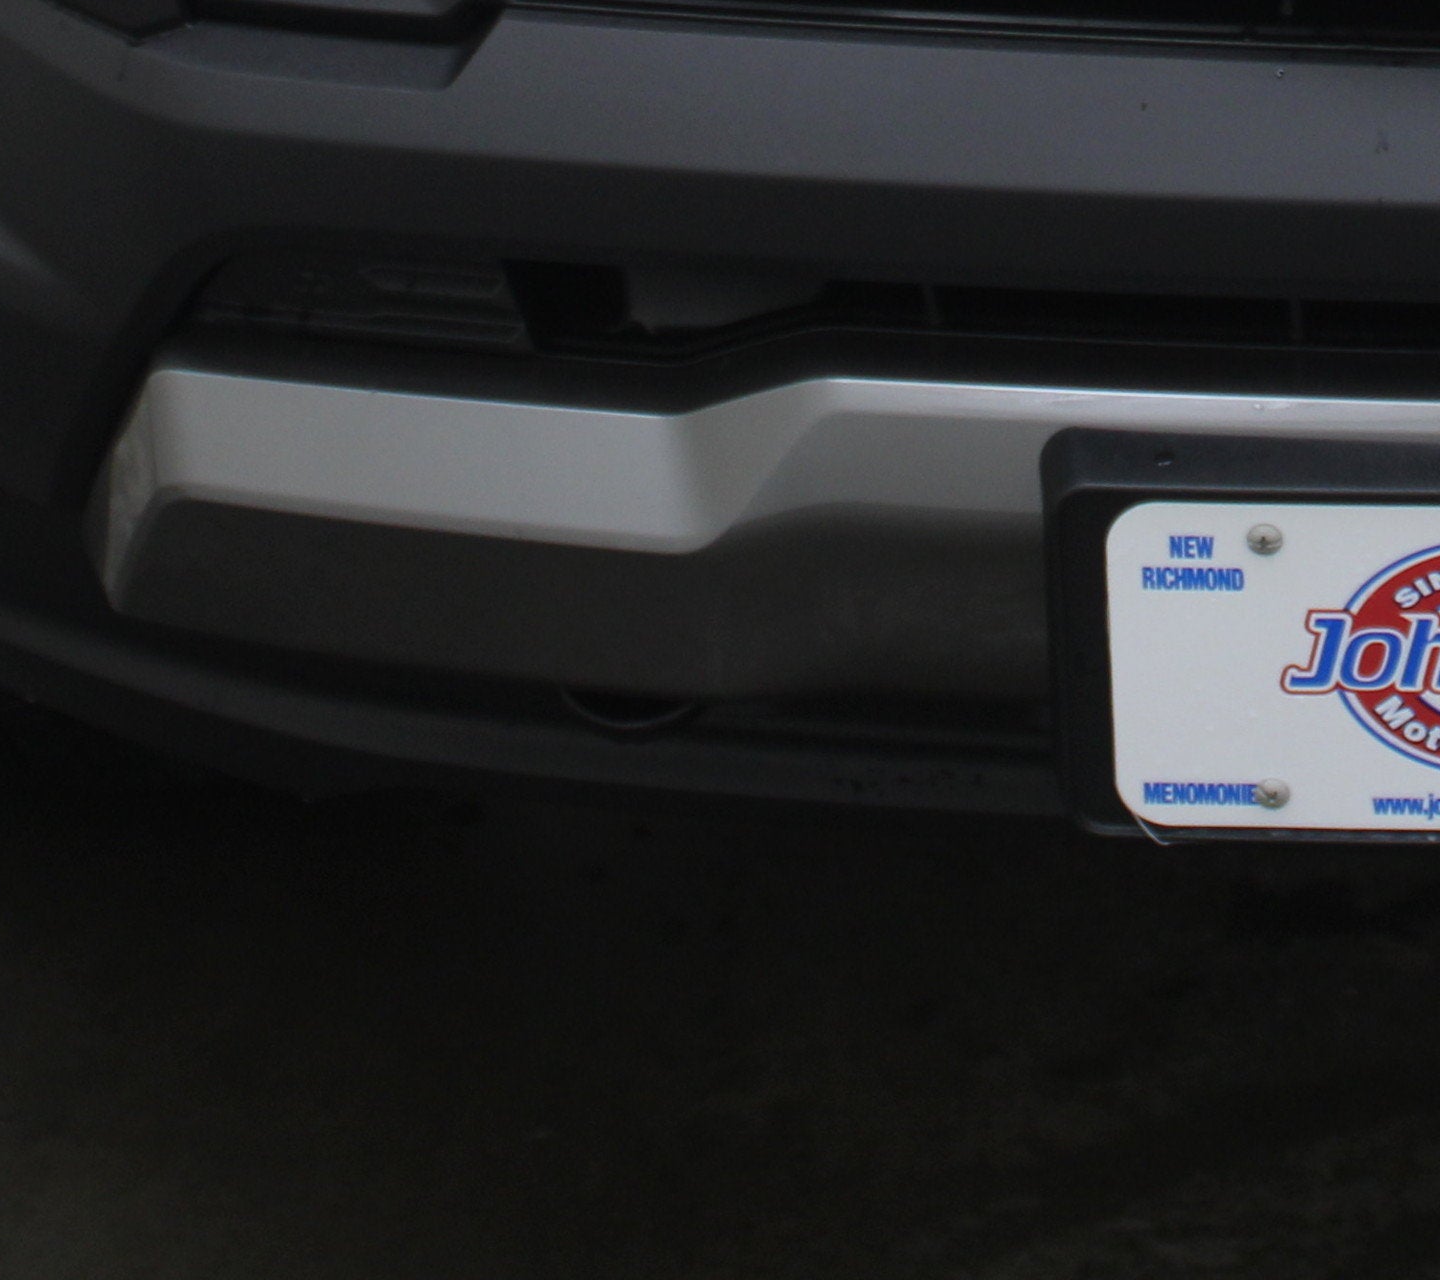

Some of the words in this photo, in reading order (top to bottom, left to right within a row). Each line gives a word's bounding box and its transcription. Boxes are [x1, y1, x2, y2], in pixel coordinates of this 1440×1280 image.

[1168, 536, 1215, 560] NEW
[1142, 567, 1245, 592] RICHMOND
[1143, 782, 1261, 806] MENOMONIE
